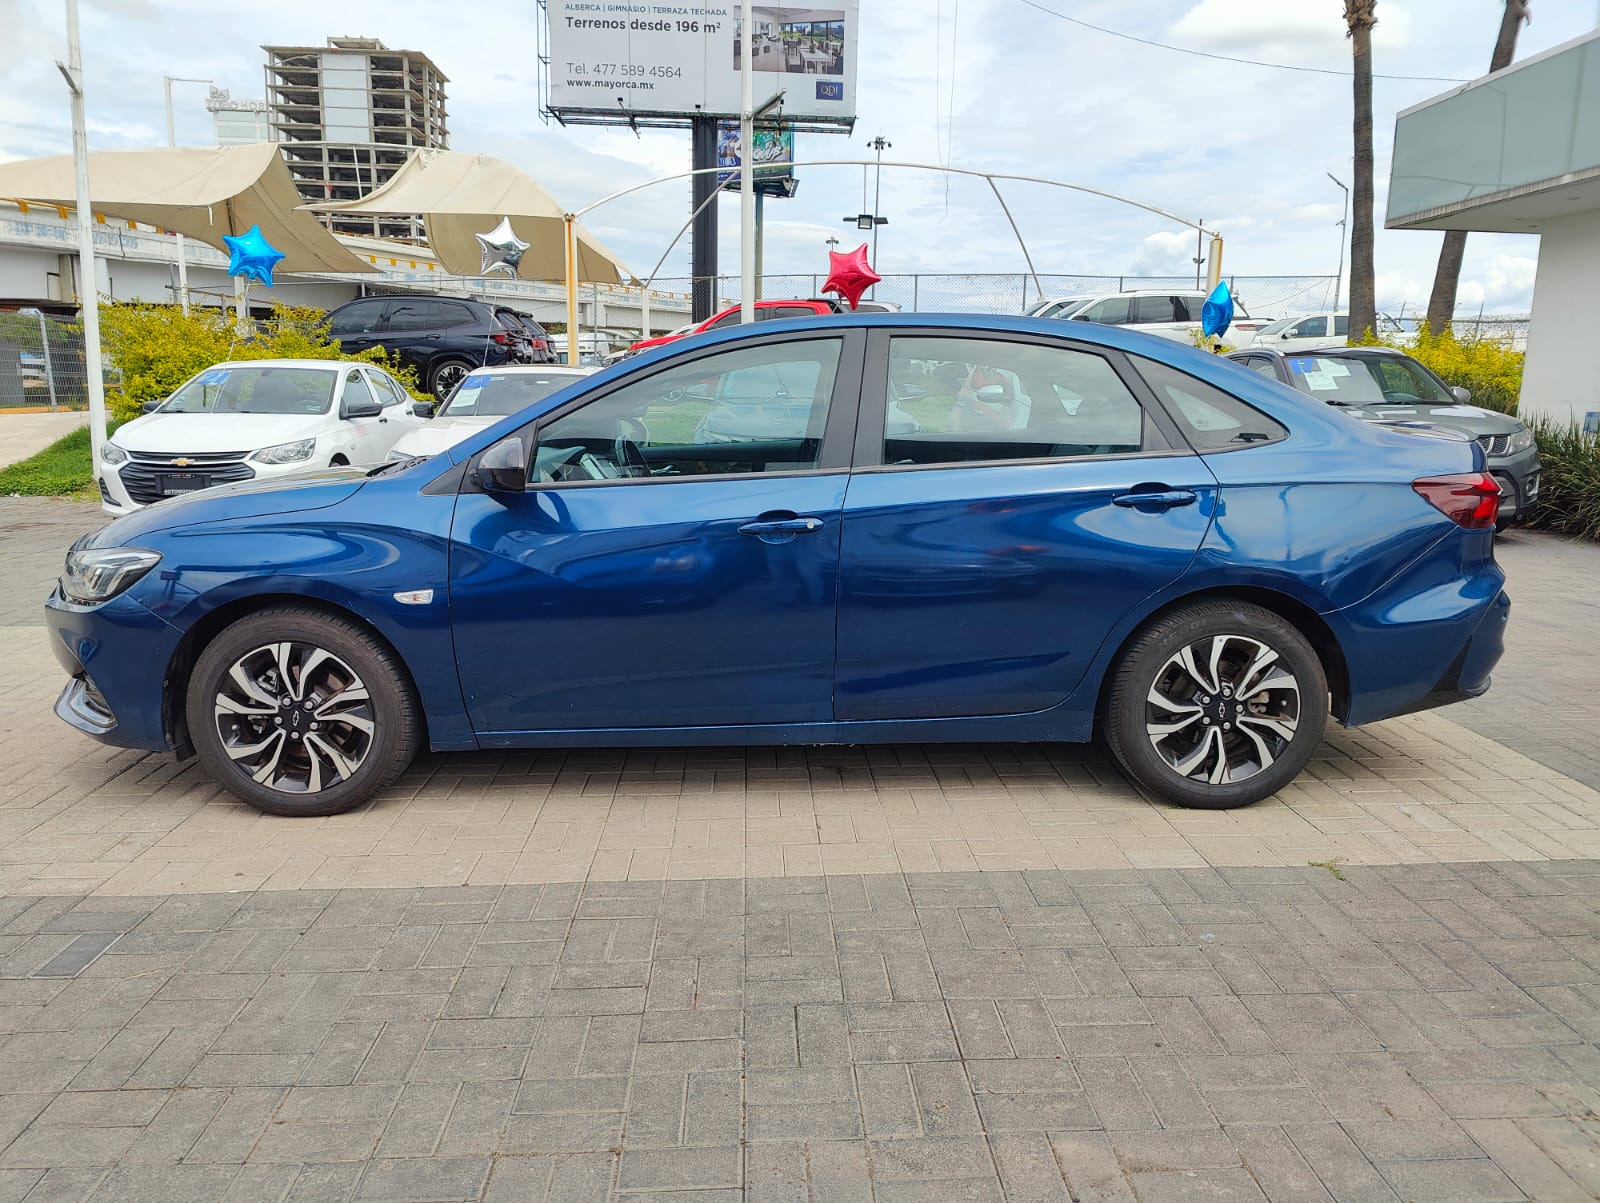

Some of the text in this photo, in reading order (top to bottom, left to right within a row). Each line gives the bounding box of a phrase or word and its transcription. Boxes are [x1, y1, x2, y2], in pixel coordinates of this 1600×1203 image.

[565, 3, 727, 16] ALBERCA GIMNASIO TERRAZA TECHADA
[565, 16, 626, 30] Terrenos
[630, 18, 671, 32] desde
[675, 20, 699, 33] 196
[566, 62, 682, 78] Tel. 477 589 4564
[566, 79, 655, 90] www.mayorca.mx
